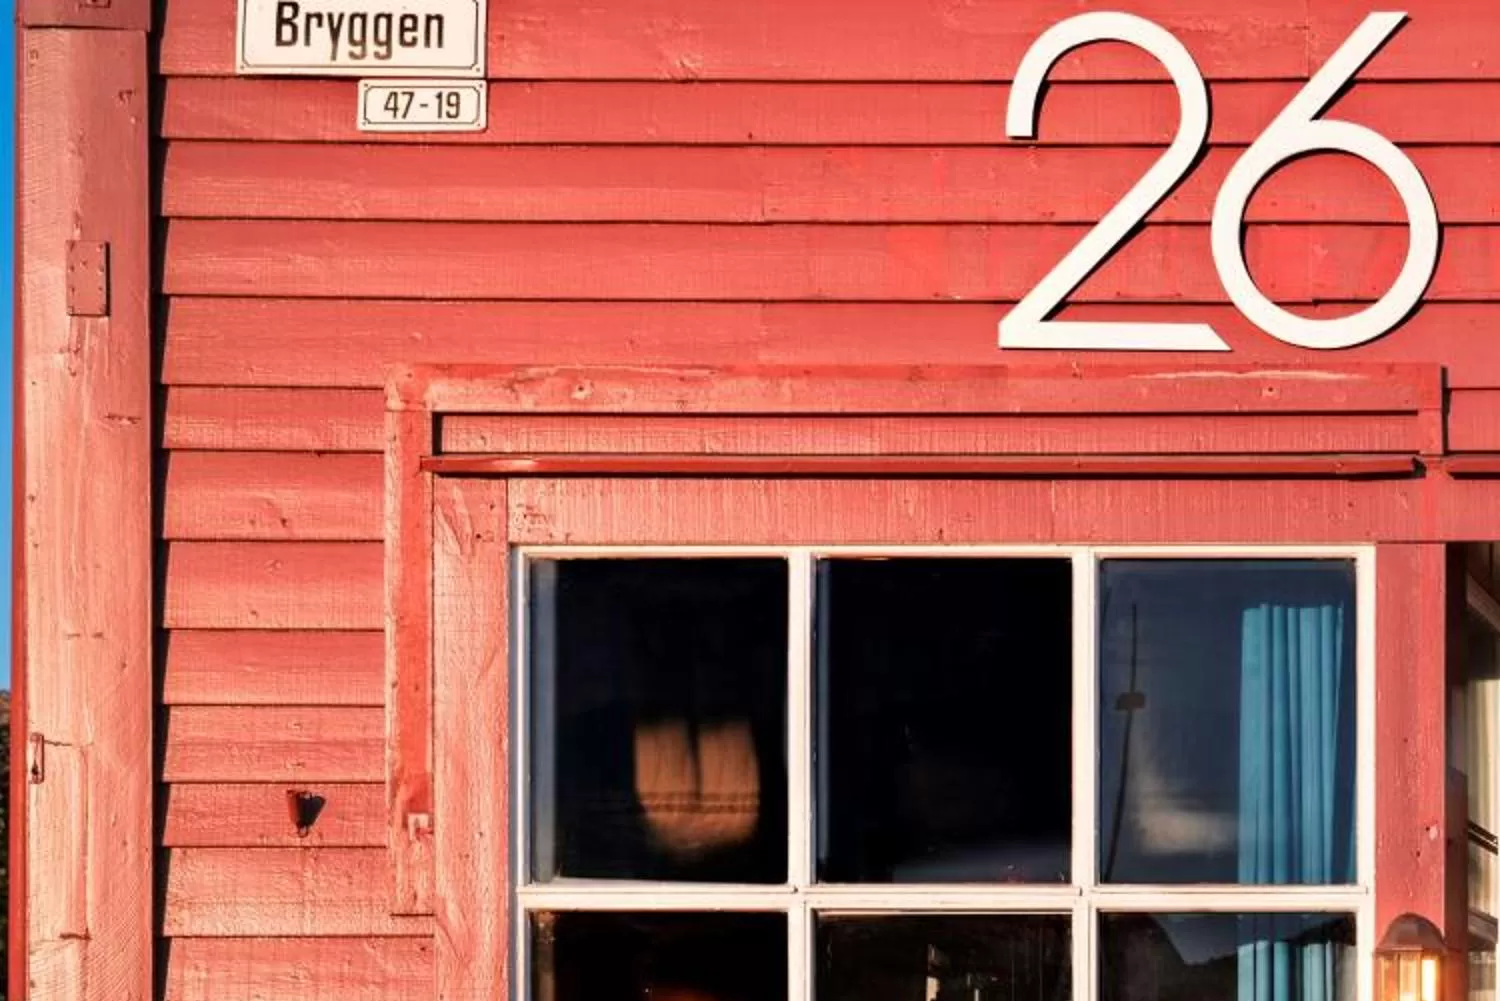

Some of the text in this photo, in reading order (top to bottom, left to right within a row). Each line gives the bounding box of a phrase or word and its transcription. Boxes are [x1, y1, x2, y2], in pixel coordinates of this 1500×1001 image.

[275, 1, 444, 61] Bryggen
[383, 91, 461, 119] 47-19
[998, 11, 1438, 351] 26
